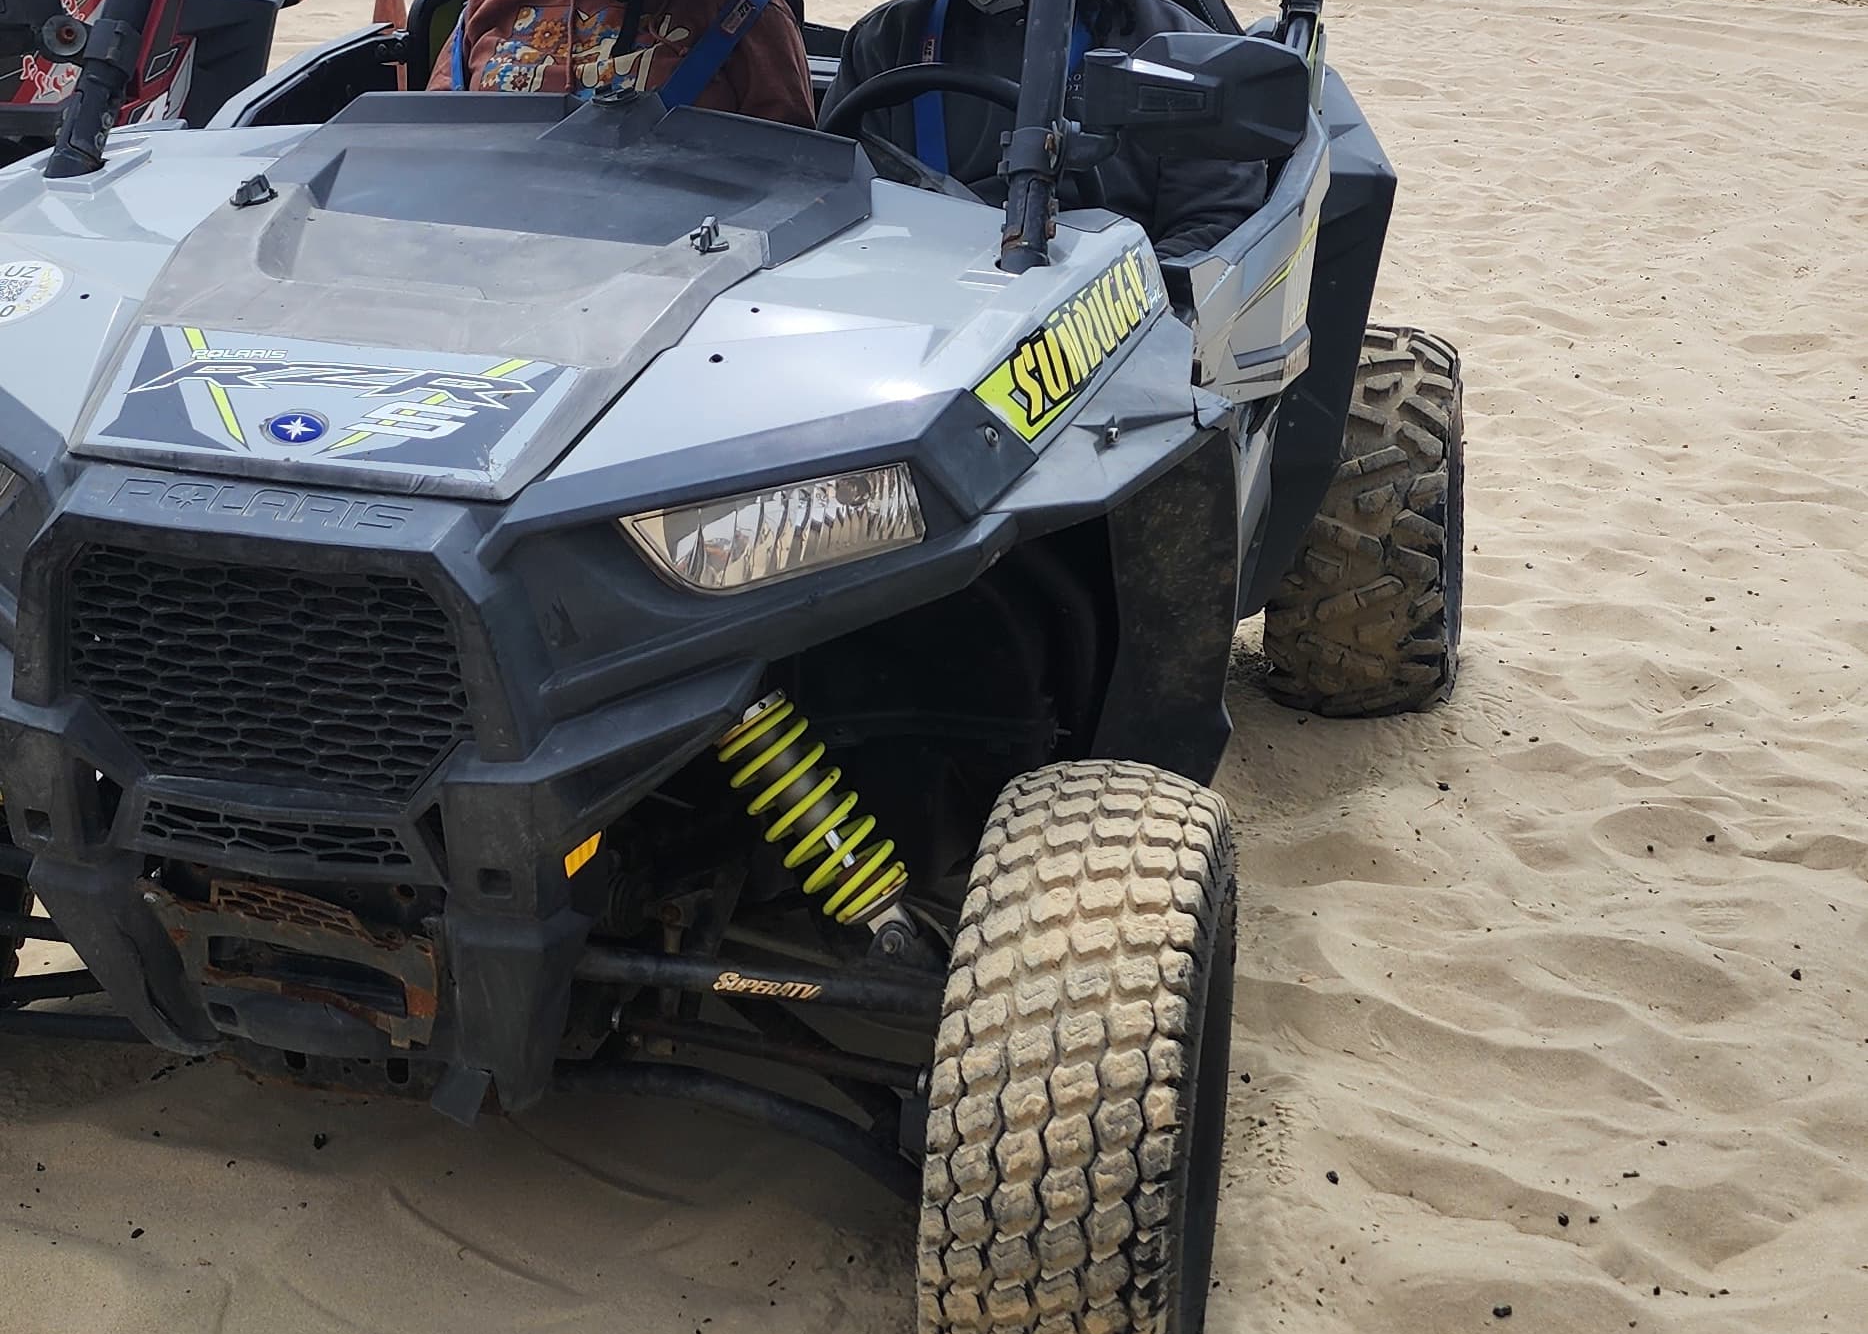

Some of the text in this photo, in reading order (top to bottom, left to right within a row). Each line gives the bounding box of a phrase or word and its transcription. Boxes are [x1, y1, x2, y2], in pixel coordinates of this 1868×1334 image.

[191, 348, 289, 360] POLARIS
[1010, 249, 1151, 425] SUNBUGGY
[124, 358, 536, 410] RZR
[105, 477, 414, 534] POLARIS
